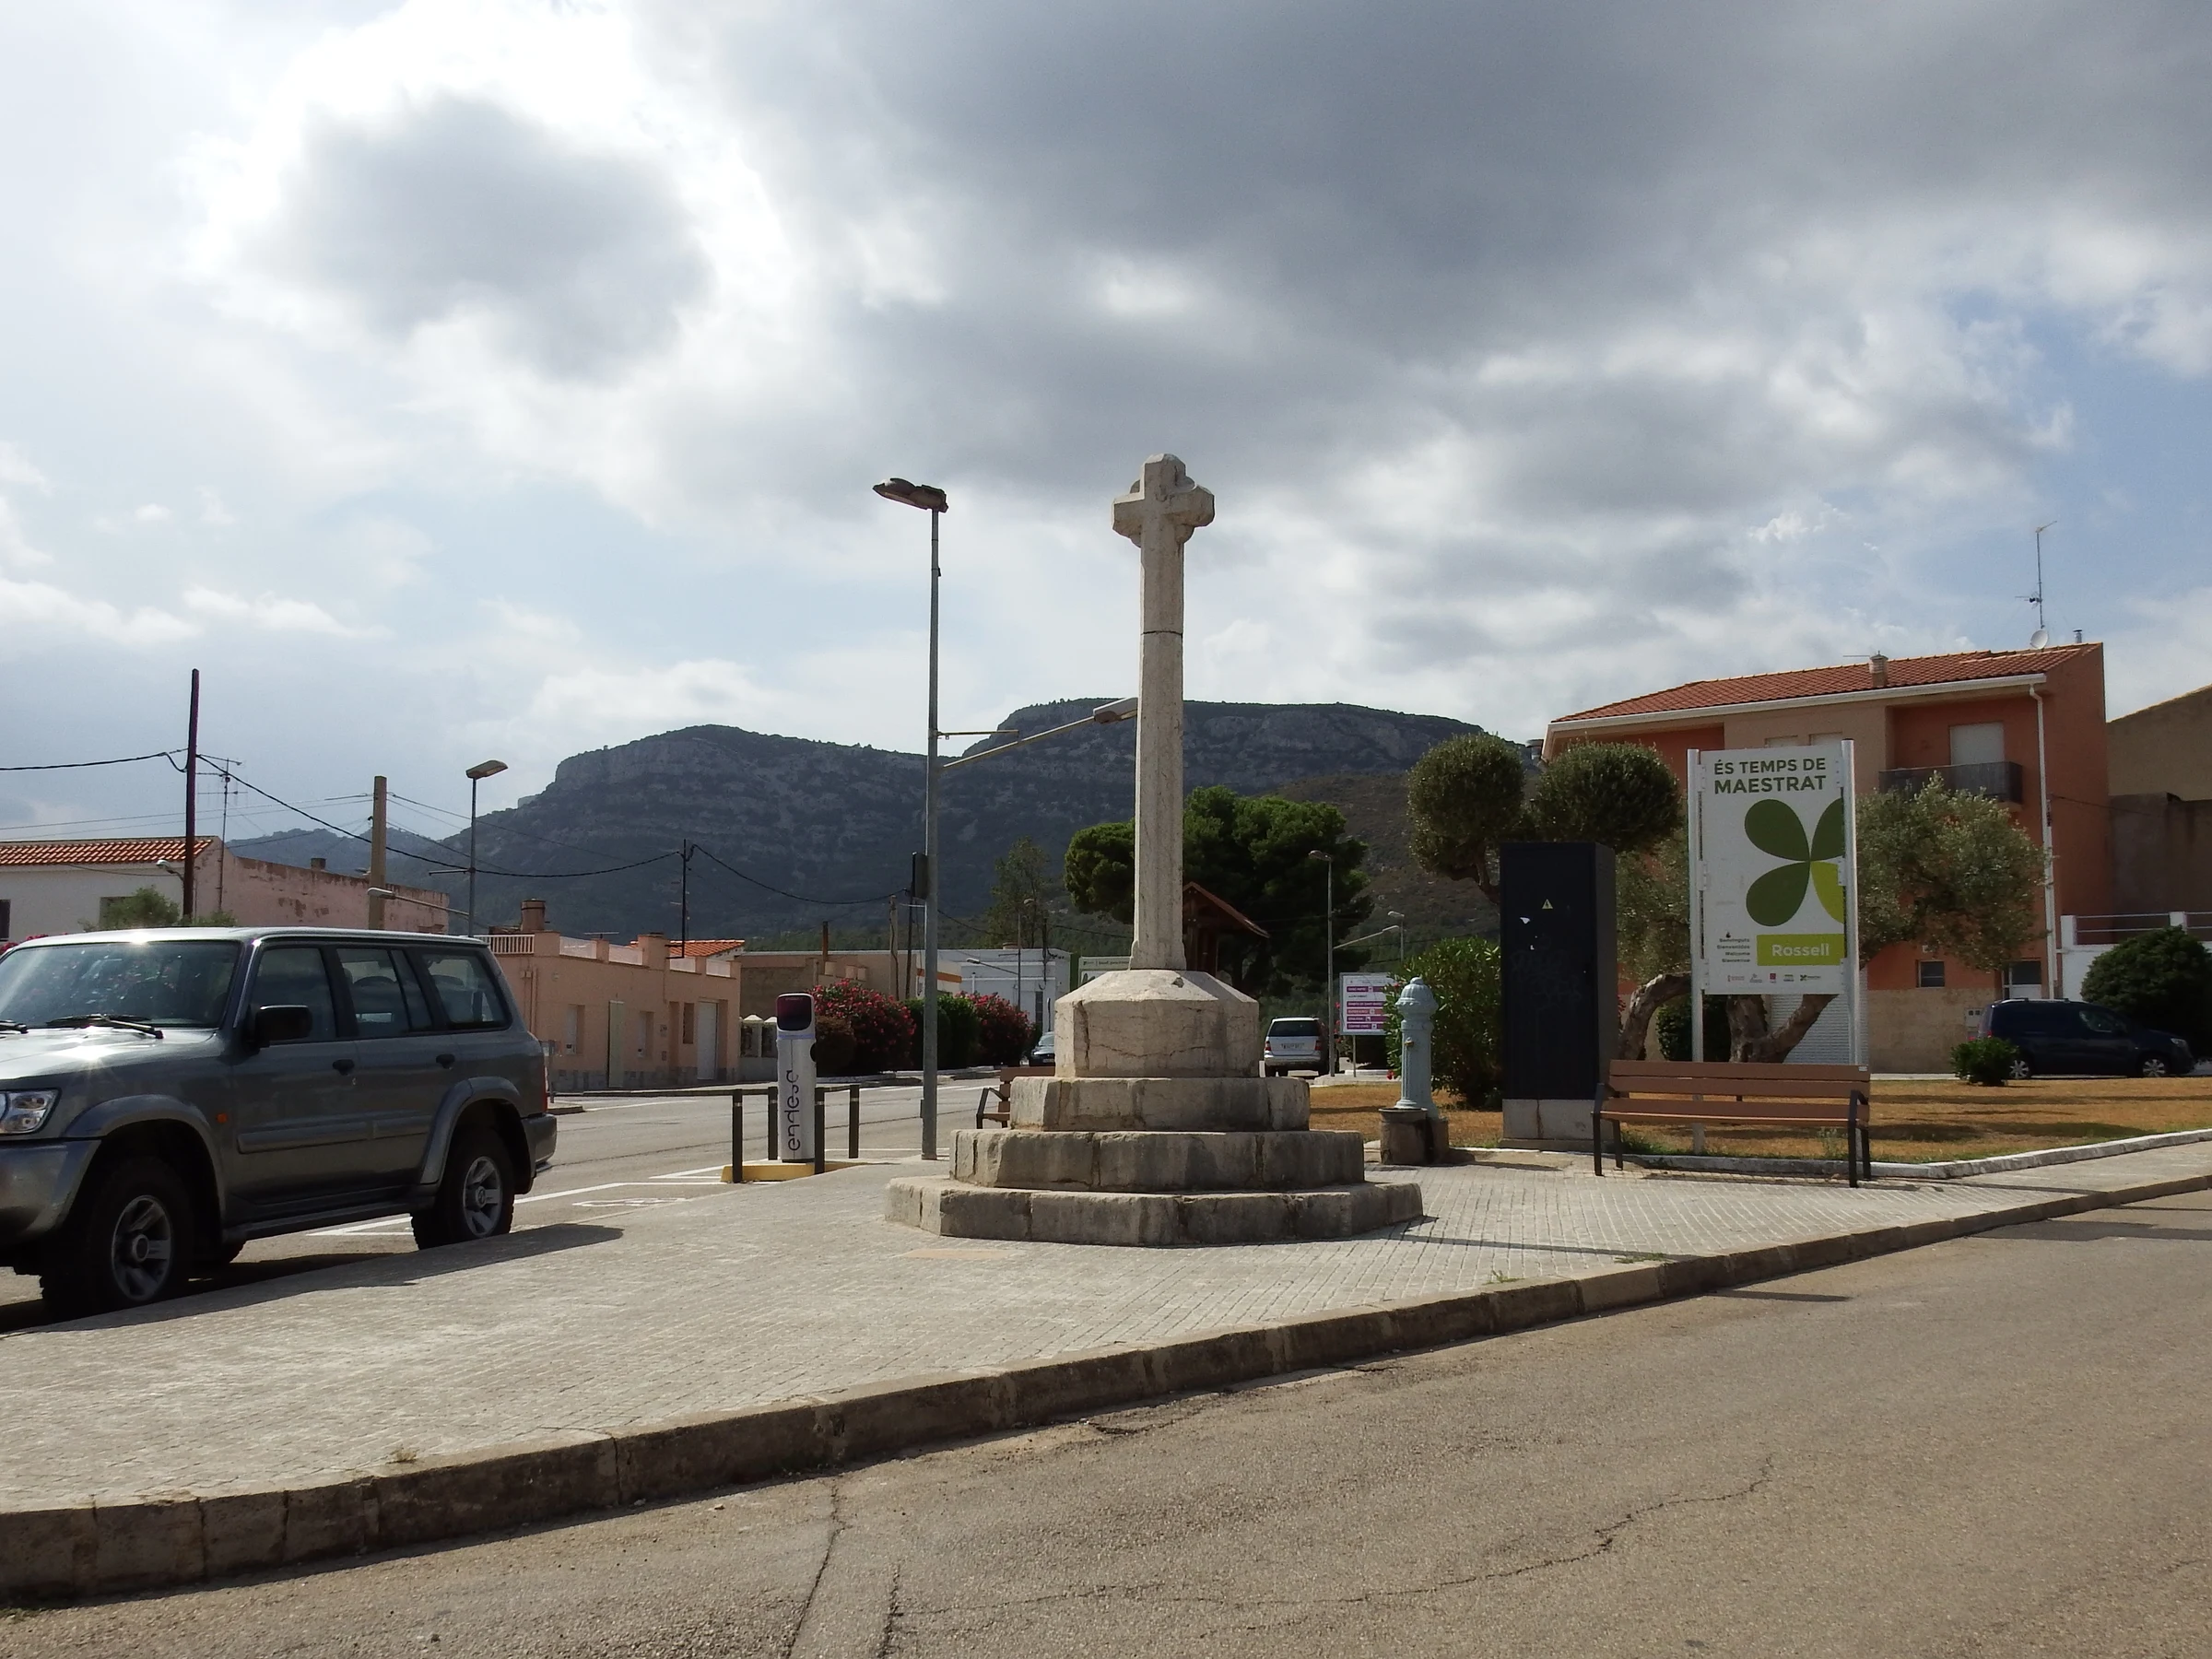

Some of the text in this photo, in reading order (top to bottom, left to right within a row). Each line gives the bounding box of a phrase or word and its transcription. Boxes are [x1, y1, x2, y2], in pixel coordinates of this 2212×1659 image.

[1714, 758, 1826, 775] ÉS TEMPS DE
[1714, 775, 1826, 794] MAESTRAT
[1771, 943, 1830, 957] Rossell
